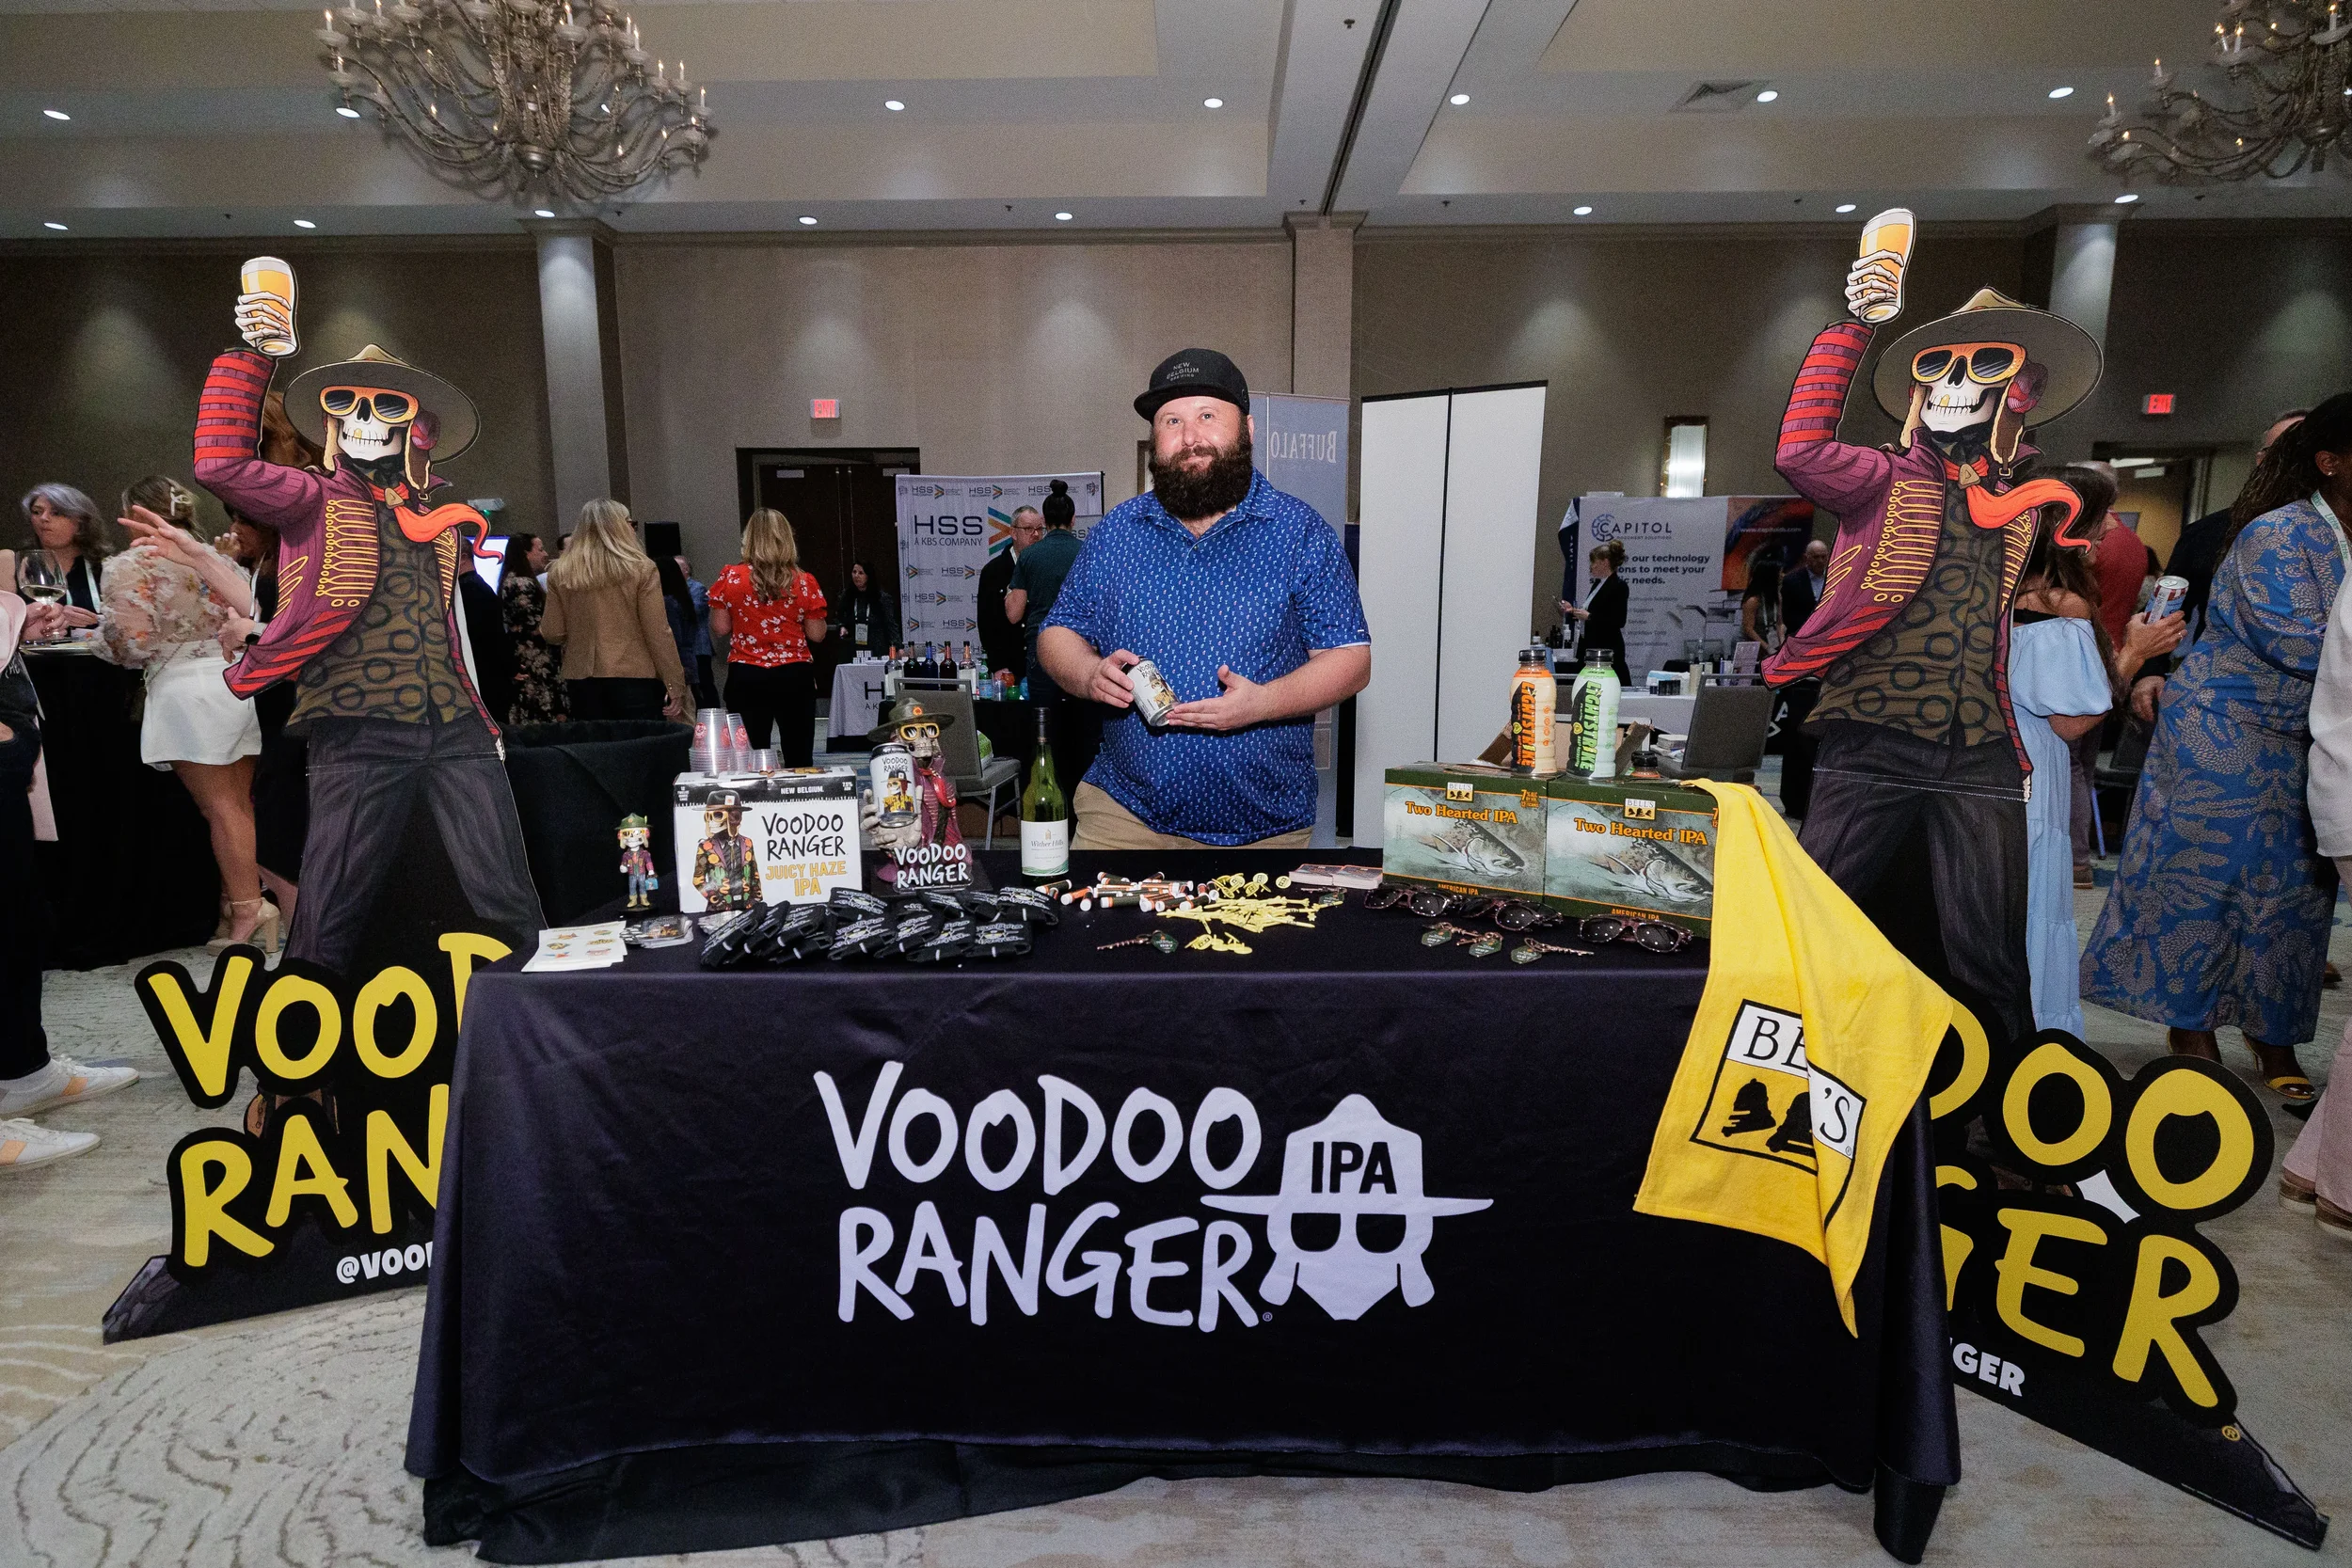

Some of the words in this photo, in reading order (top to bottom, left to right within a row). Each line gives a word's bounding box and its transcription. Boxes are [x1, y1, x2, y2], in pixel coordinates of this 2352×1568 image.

[1167, 368, 1200, 380] BELGIUM
[1172, 361, 1190, 370] NEW
[815, 399, 835, 418] EXIT
[912, 485, 933, 494] HSS
[914, 515, 983, 536] HSS
[1599, 522, 1672, 534] CAPITOL
[914, 537, 919, 546] A
[921, 537, 938, 546] KBS
[940, 537, 983, 546] COMPANY
[1652, 554, 1710, 563] technology
[1632, 576, 1666, 584] needs.
[1681, 566, 1706, 575] your
[797, 785, 823, 794] BELGIUM
[1406, 801, 1432, 816] Two
[1436, 805, 1489, 821] Hearted
[1493, 810, 1518, 824] IPA
[1627, 799, 1654, 808] BELL'S
[762, 813, 844, 836] VOODOO
[1574, 817, 1606, 834] Two
[1610, 822, 1675, 842] Hearted
[1679, 829, 1708, 846] IPA
[767, 834, 846, 861] RANGER
[894, 843, 966, 865] VOODOO
[765, 864, 806, 881] JUICY
[809, 861, 847, 878] HAZE
[897, 863, 969, 888] RANGER
[794, 878, 821, 896] IPA
[1438, 883, 1468, 895] AMERICAN
[1469, 887, 1479, 895] IPA
[148, 932, 512, 1097] VOO
[1743, 1016, 1851, 1144] BE'S
[1930, 999, 2254, 1210] DOO
[814, 1061, 1262, 1196] VOODOO
[180, 1084, 449, 1267] RAN
[1312, 1141, 1397, 1194] IPA
[837, 1201, 1259, 1332] RANGER
[1950, 1338, 2026, 1397] GER
